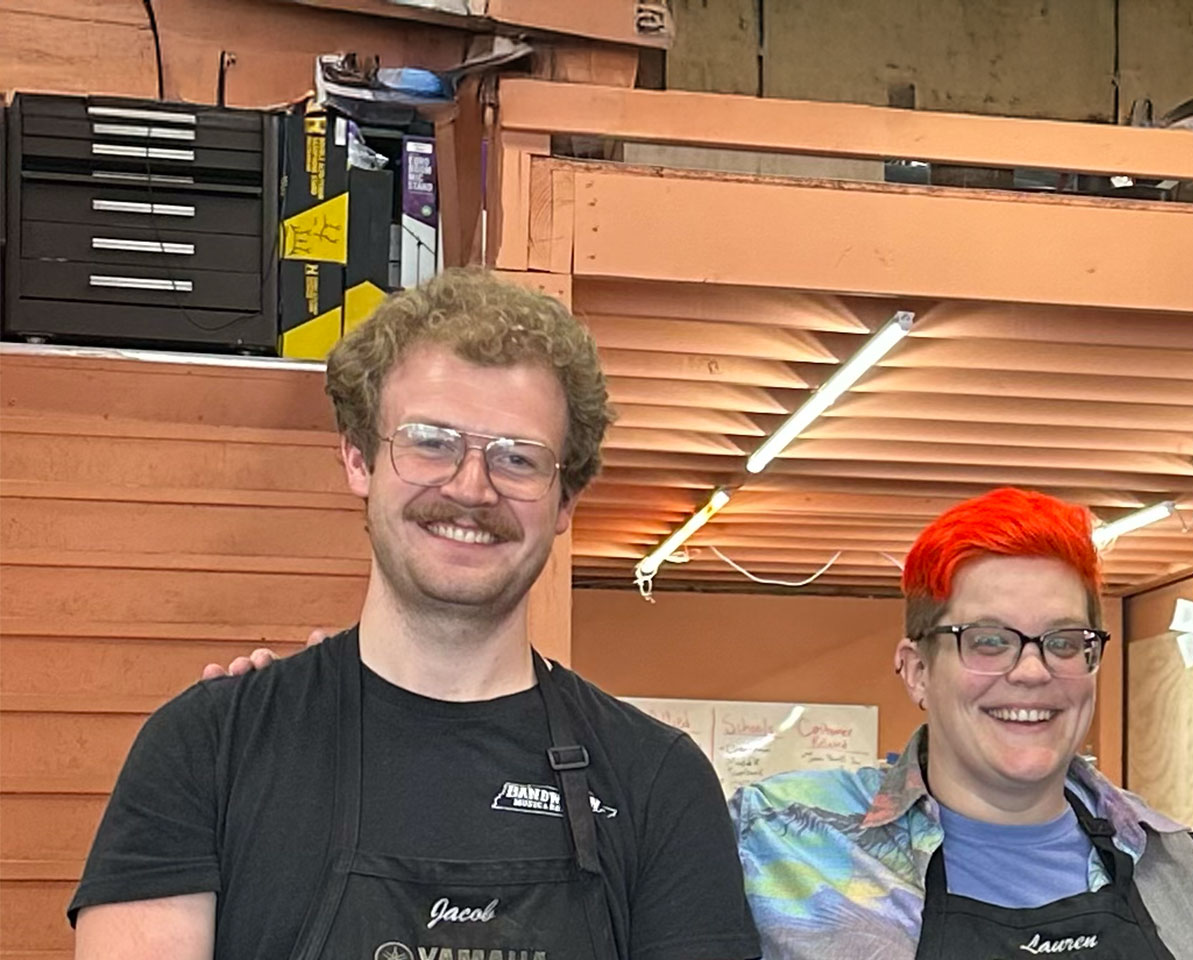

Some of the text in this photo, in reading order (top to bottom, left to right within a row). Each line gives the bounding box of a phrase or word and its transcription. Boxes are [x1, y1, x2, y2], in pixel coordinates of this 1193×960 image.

[408, 181, 433, 192] STAND
[513, 798, 541, 808] MUSIC
[427, 897, 499, 929] Jacob
[1019, 933, 1098, 955] Lauren
